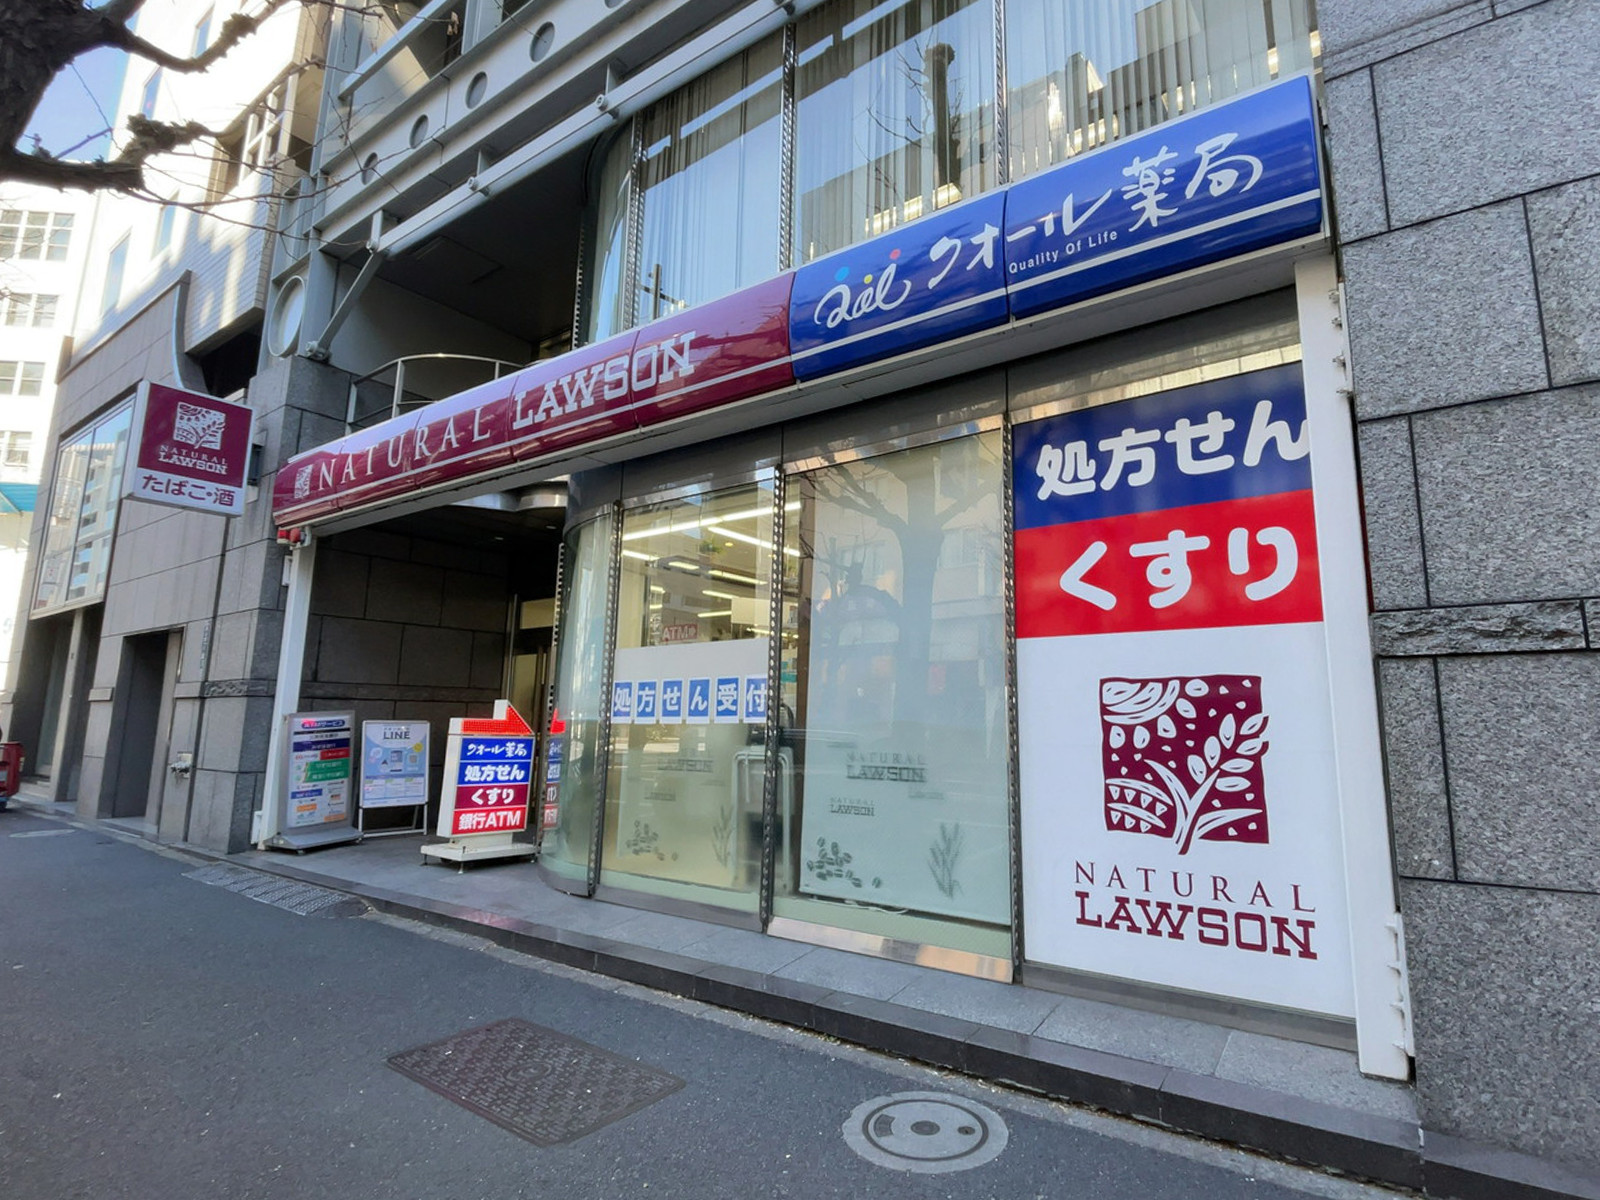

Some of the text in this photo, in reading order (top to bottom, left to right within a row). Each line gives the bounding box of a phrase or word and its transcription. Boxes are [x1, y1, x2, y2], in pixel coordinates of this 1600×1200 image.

[927, 132, 1264, 288] クオール薬局
[1008, 229, 1119, 274] Quality Of Life
[318, 330, 697, 492] NATURAL LAWSON
[159, 444, 228, 466] NATURAL
[1035, 400, 1311, 501] 処方せん
[158, 452, 228, 475] LAWSON
[142, 474, 236, 507] たばこ・酒
[1059, 526, 1299, 611] くすり
[662, 624, 689, 641] ATM
[614, 682, 767, 713] 処方せん受付
[383, 731, 411, 740] LINE
[466, 741, 528, 758] クオール薬局
[464, 764, 525, 783] 処方せん
[846, 764, 927, 783] LAWSON
[471, 787, 515, 805] くすり
[458, 810, 521, 831] 銀行ATM
[830, 803, 875, 816] LAWSON
[1074, 860, 1316, 913] NATURAL
[1075, 890, 1318, 961] LAWSON
